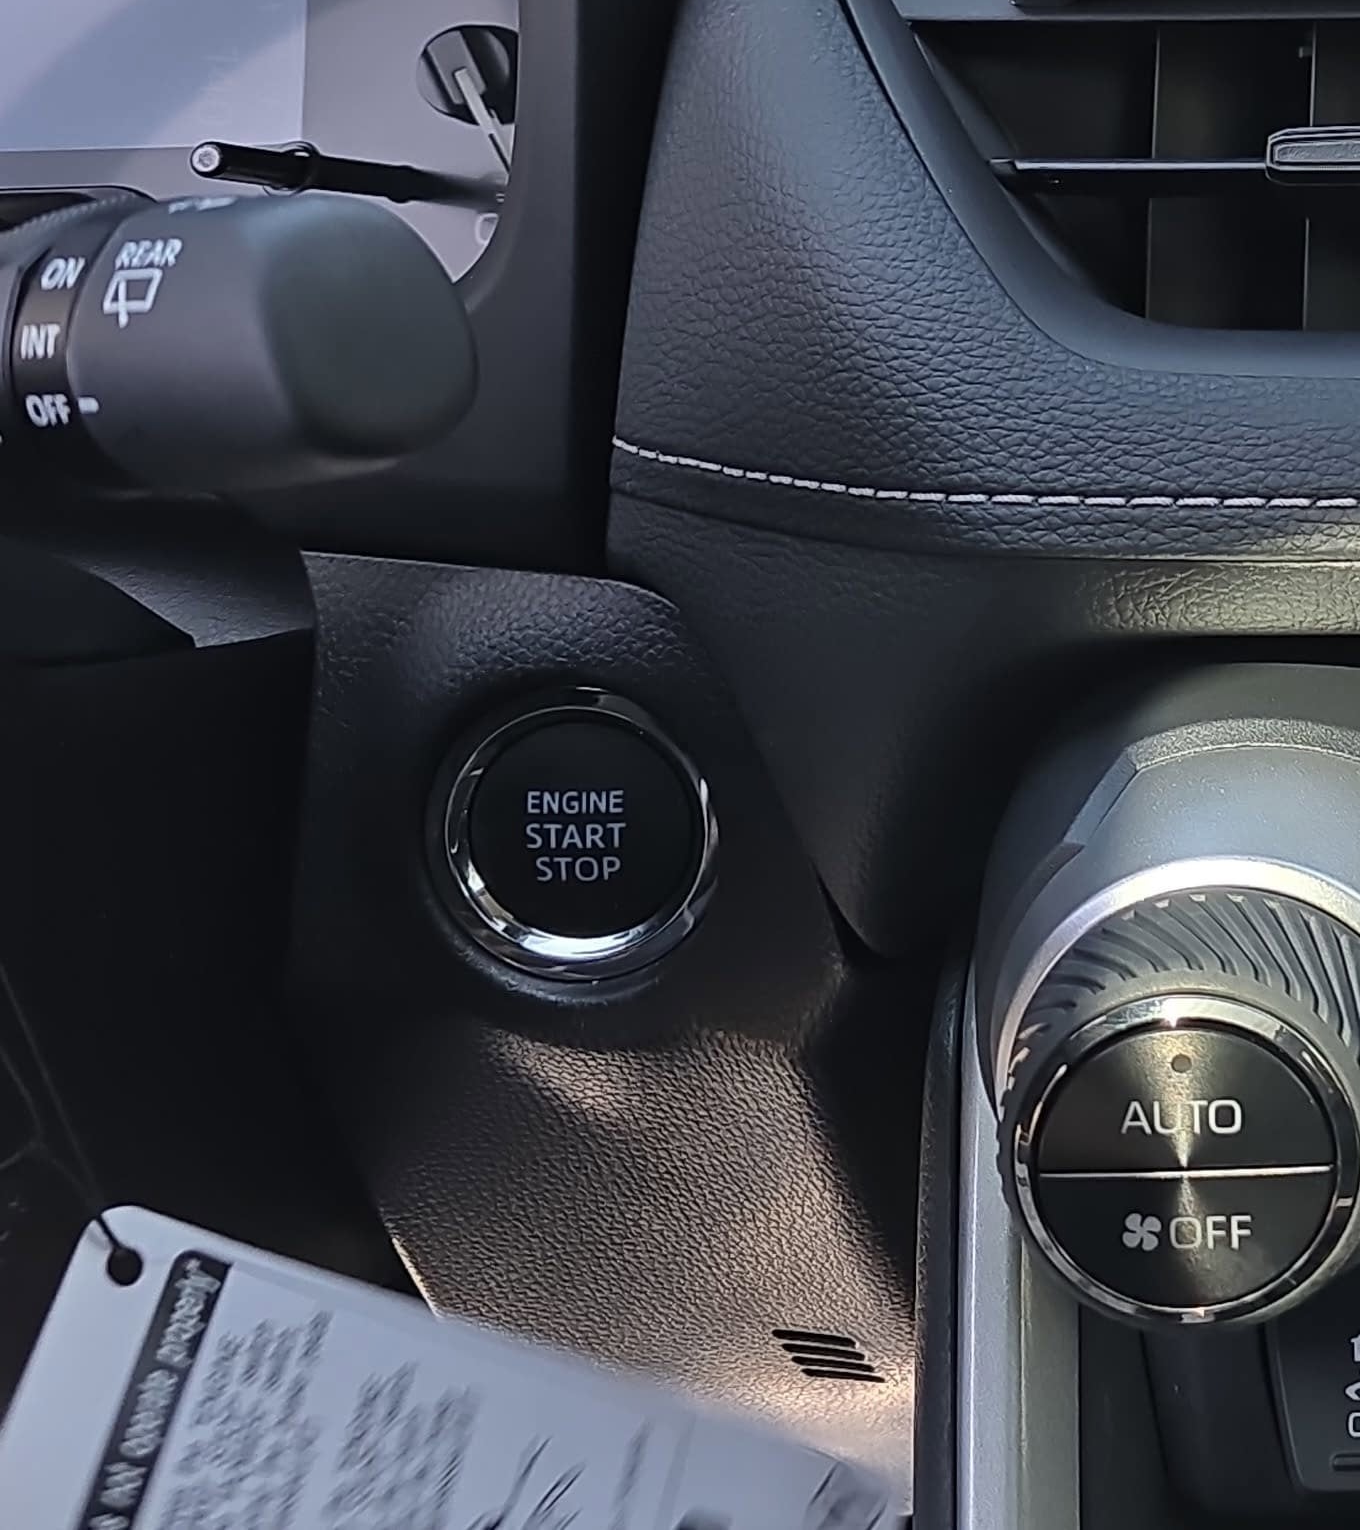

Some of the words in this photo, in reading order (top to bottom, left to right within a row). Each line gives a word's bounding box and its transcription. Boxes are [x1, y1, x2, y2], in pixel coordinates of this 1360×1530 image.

[115, 239, 183, 268] REAR
[41, 257, 84, 290] ON
[20, 324, 60, 359] INT
[26, 394, 71, 427] OFF
[527, 789, 625, 815] ENGINE
[525, 822, 627, 850] START
[535, 856, 621, 882] STOP
[1120, 1098, 1242, 1136] AUTO
[1169, 1214, 1253, 1250] OFF
